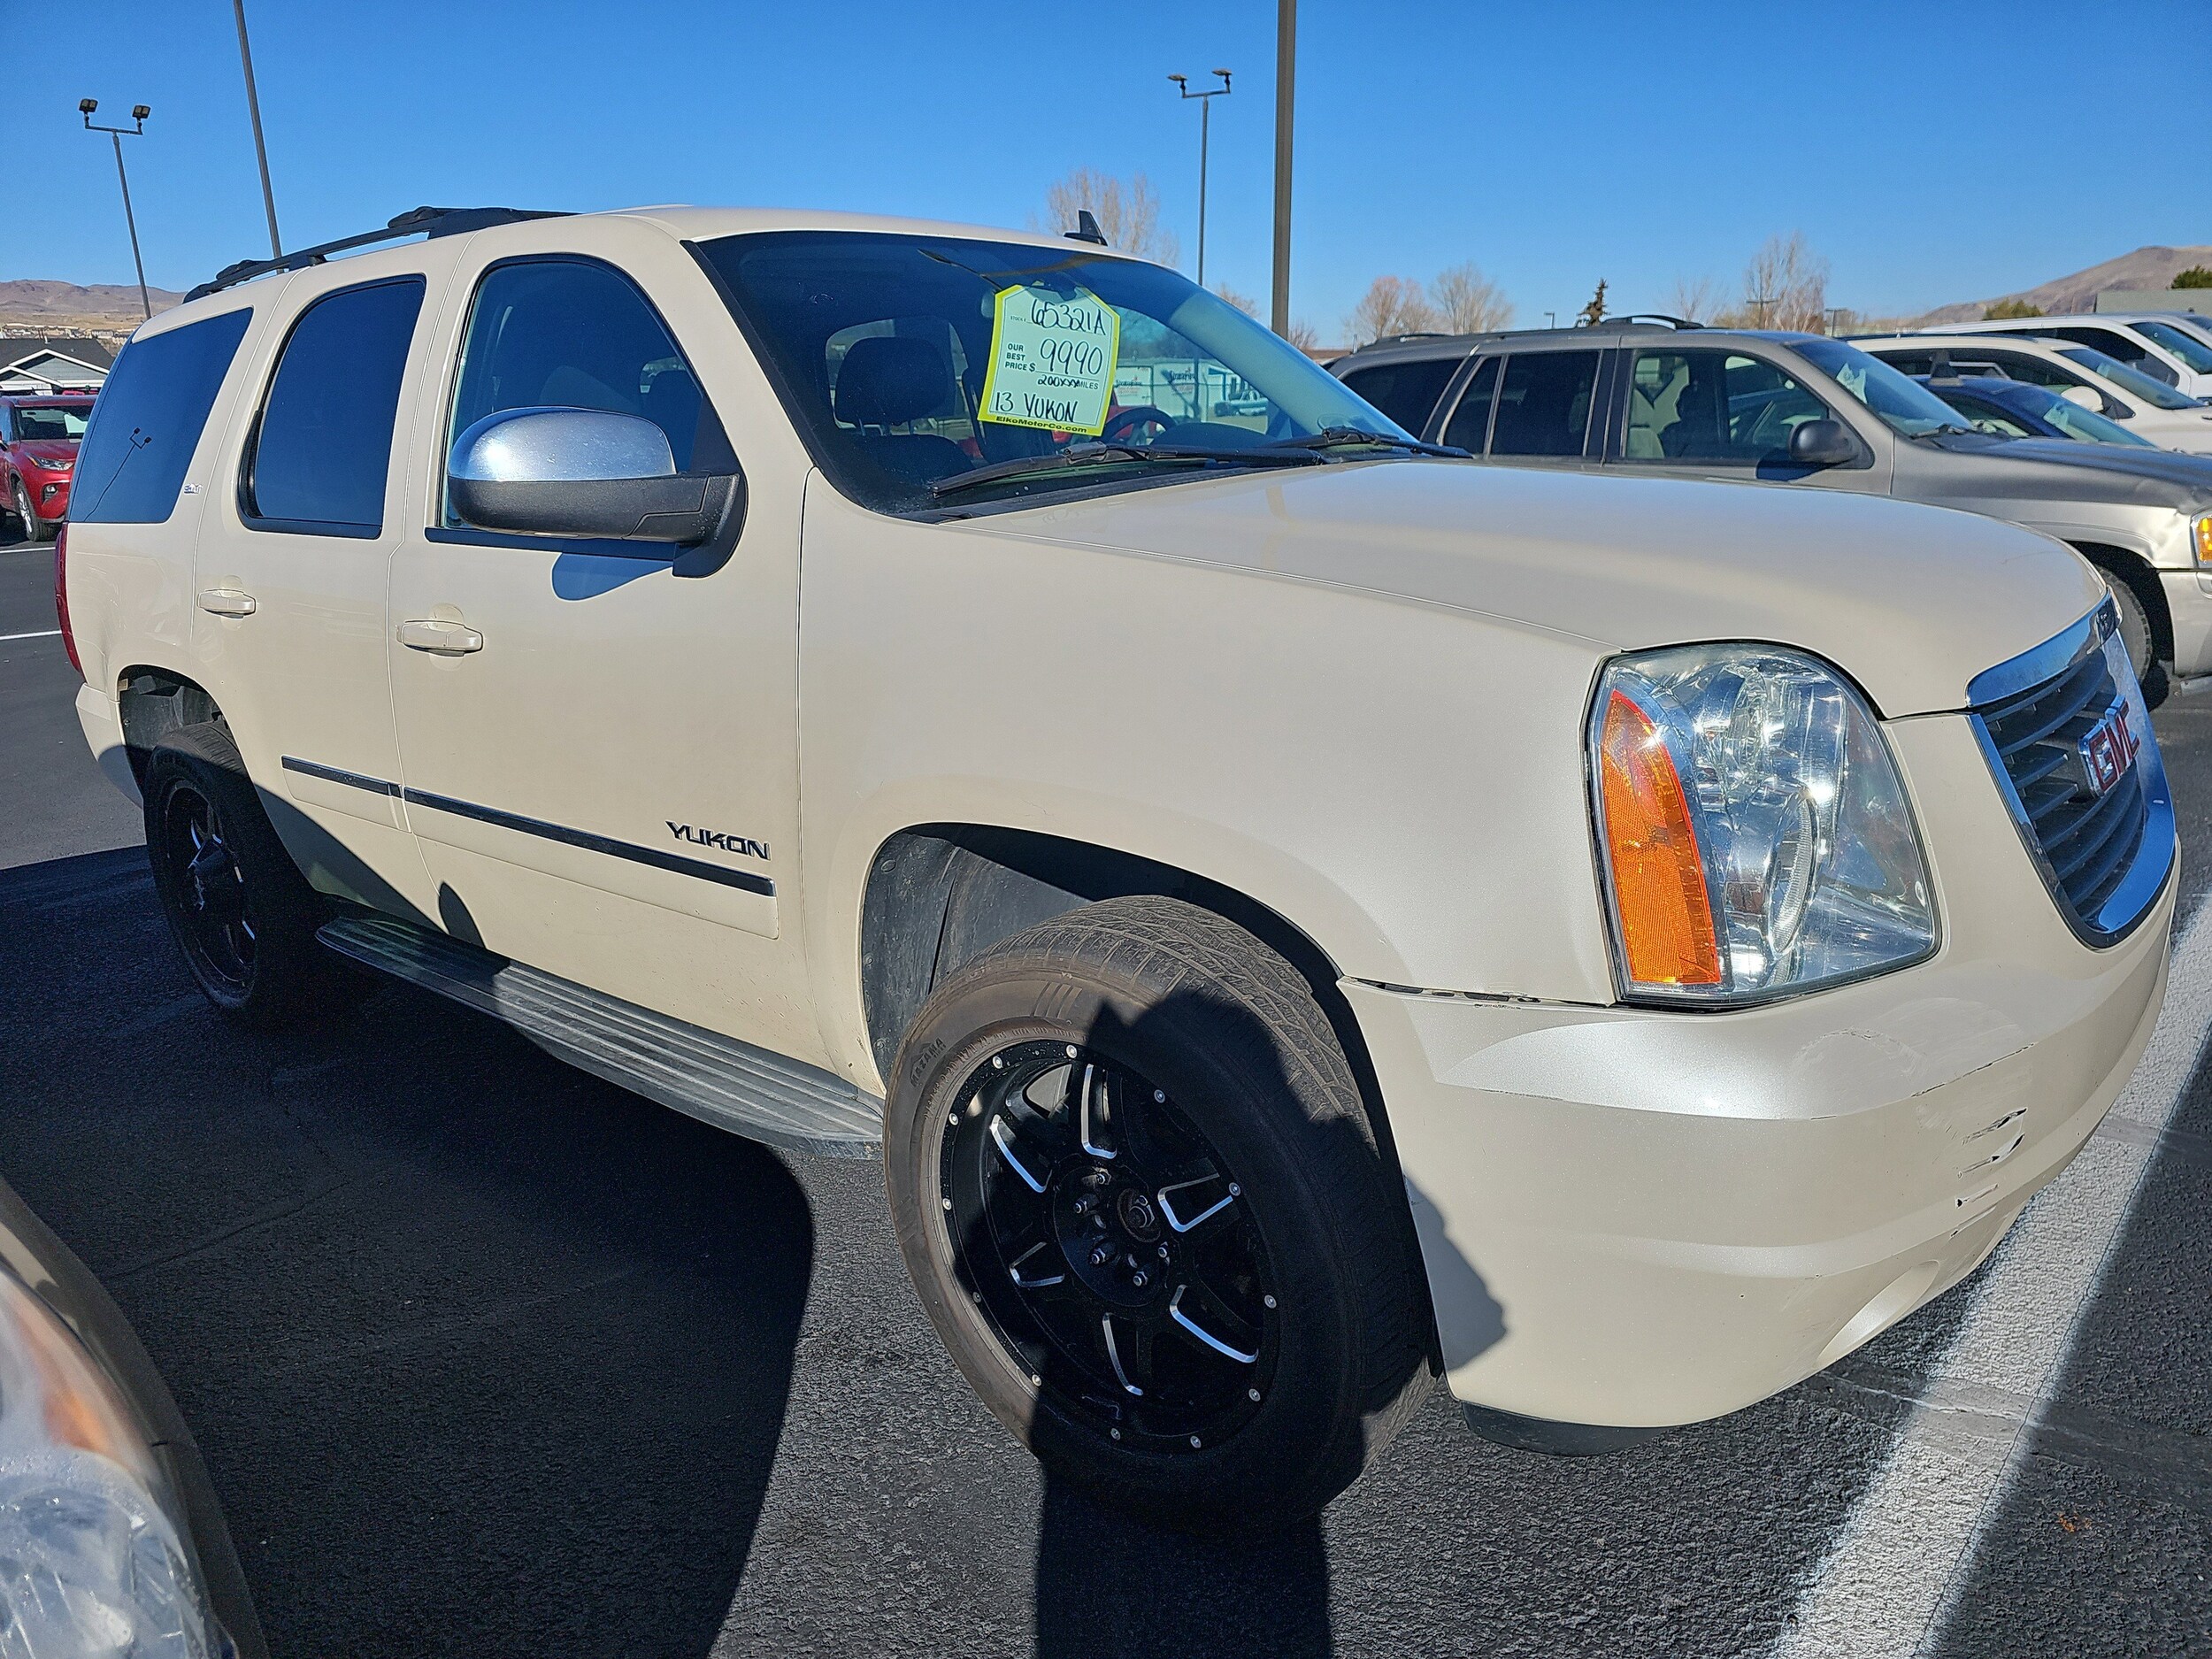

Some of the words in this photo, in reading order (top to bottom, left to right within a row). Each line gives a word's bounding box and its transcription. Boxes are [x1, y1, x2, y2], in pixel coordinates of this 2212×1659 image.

[1031, 298, 1106, 336] 65321A
[1004, 361, 1027, 371] PRICE
[1028, 362, 1036, 373] $
[1040, 338, 1103, 375] 9990
[1006, 352, 1026, 361] BEST
[1007, 342, 1024, 352] OUR
[995, 392, 1014, 412] 13
[1023, 392, 1079, 423] YUKON
[995, 416, 1087, 434] ElkoMotorCo.com
[2078, 695, 2140, 798] GMC
[664, 820, 772, 861] YUKON
